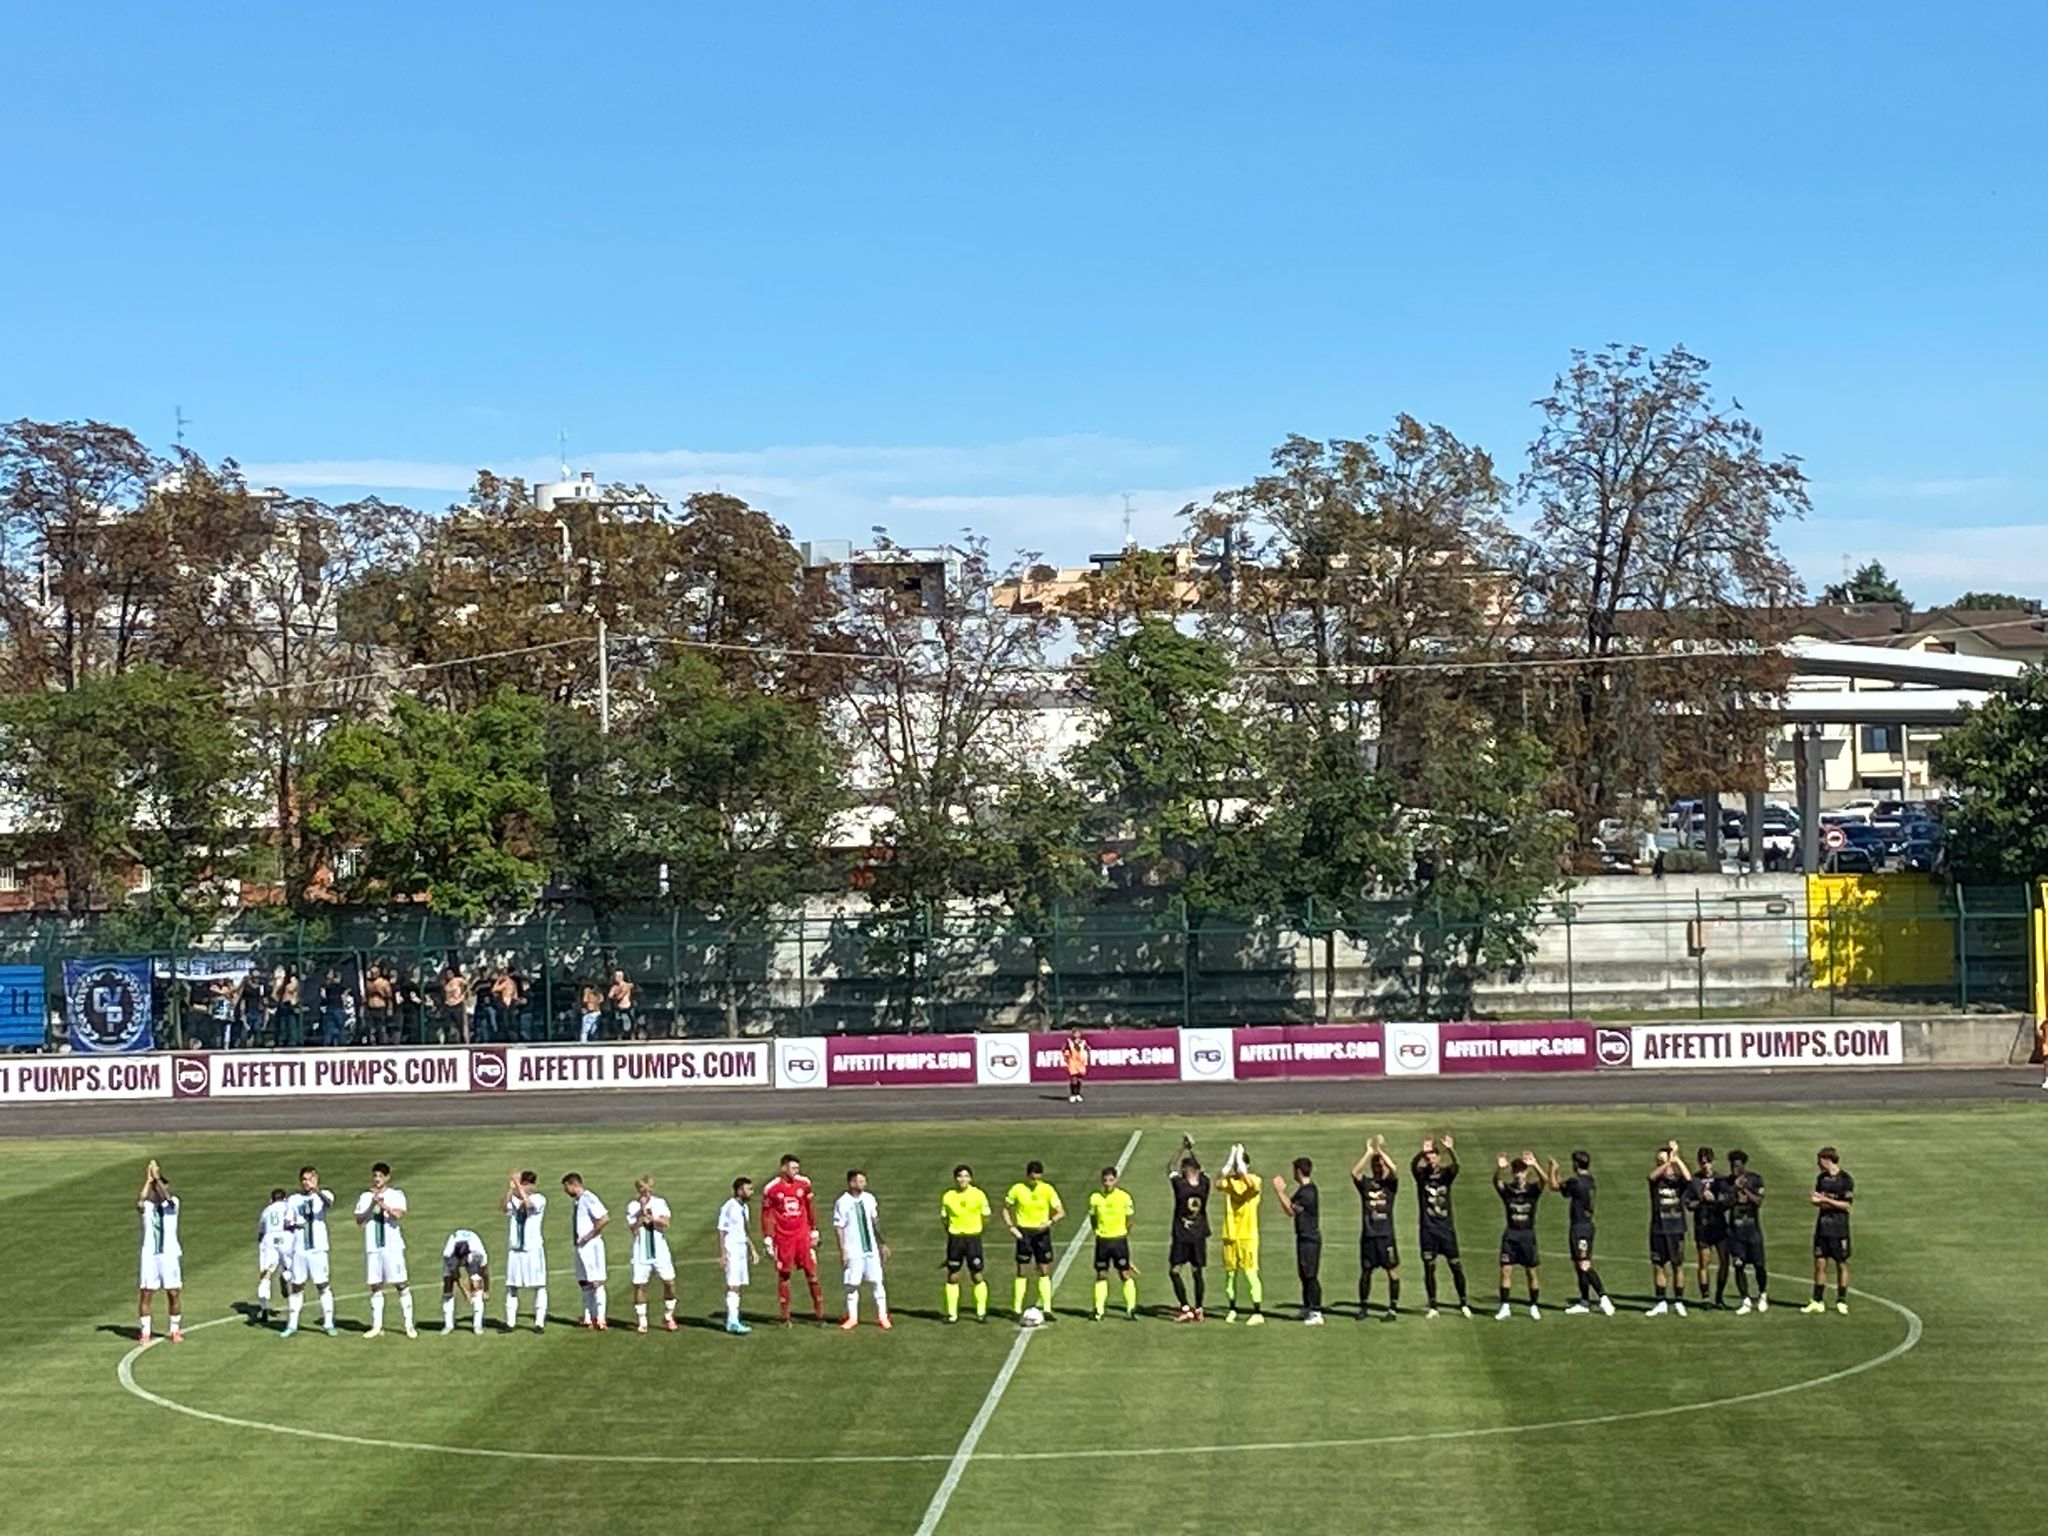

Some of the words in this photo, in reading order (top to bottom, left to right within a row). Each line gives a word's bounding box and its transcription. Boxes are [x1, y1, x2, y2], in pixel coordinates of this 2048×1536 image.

[1240, 1044, 1293, 1062] AFFETTI
[1294, 1041, 1380, 1060] PUMPS.COM
[1400, 1044, 1427, 1057] FG
[1445, 1040, 1498, 1057] AFFETTI
[1499, 1038, 1586, 1056] PUMPS.COM
[1644, 1033, 1731, 1059] AFFETTI
[1741, 1029, 1890, 1058] PUMPS.COM
[518, 1054, 603, 1081] AFFETTI
[613, 1051, 756, 1079] PUMPS.COM
[788, 1059, 815, 1071] FG
[833, 1054, 885, 1072] AFFETTI
[886, 1052, 971, 1070] PUMPS.COM
[991, 1054, 1018, 1067] FG
[1090, 1047, 1175, 1066] PUMPS.COM
[1193, 1050, 1221, 1063] FG
[18, 1063, 161, 1093] PUMPS.COM
[221, 1061, 306, 1088] AFFETTI
[315, 1058, 458, 1086] PUMPS.COM
